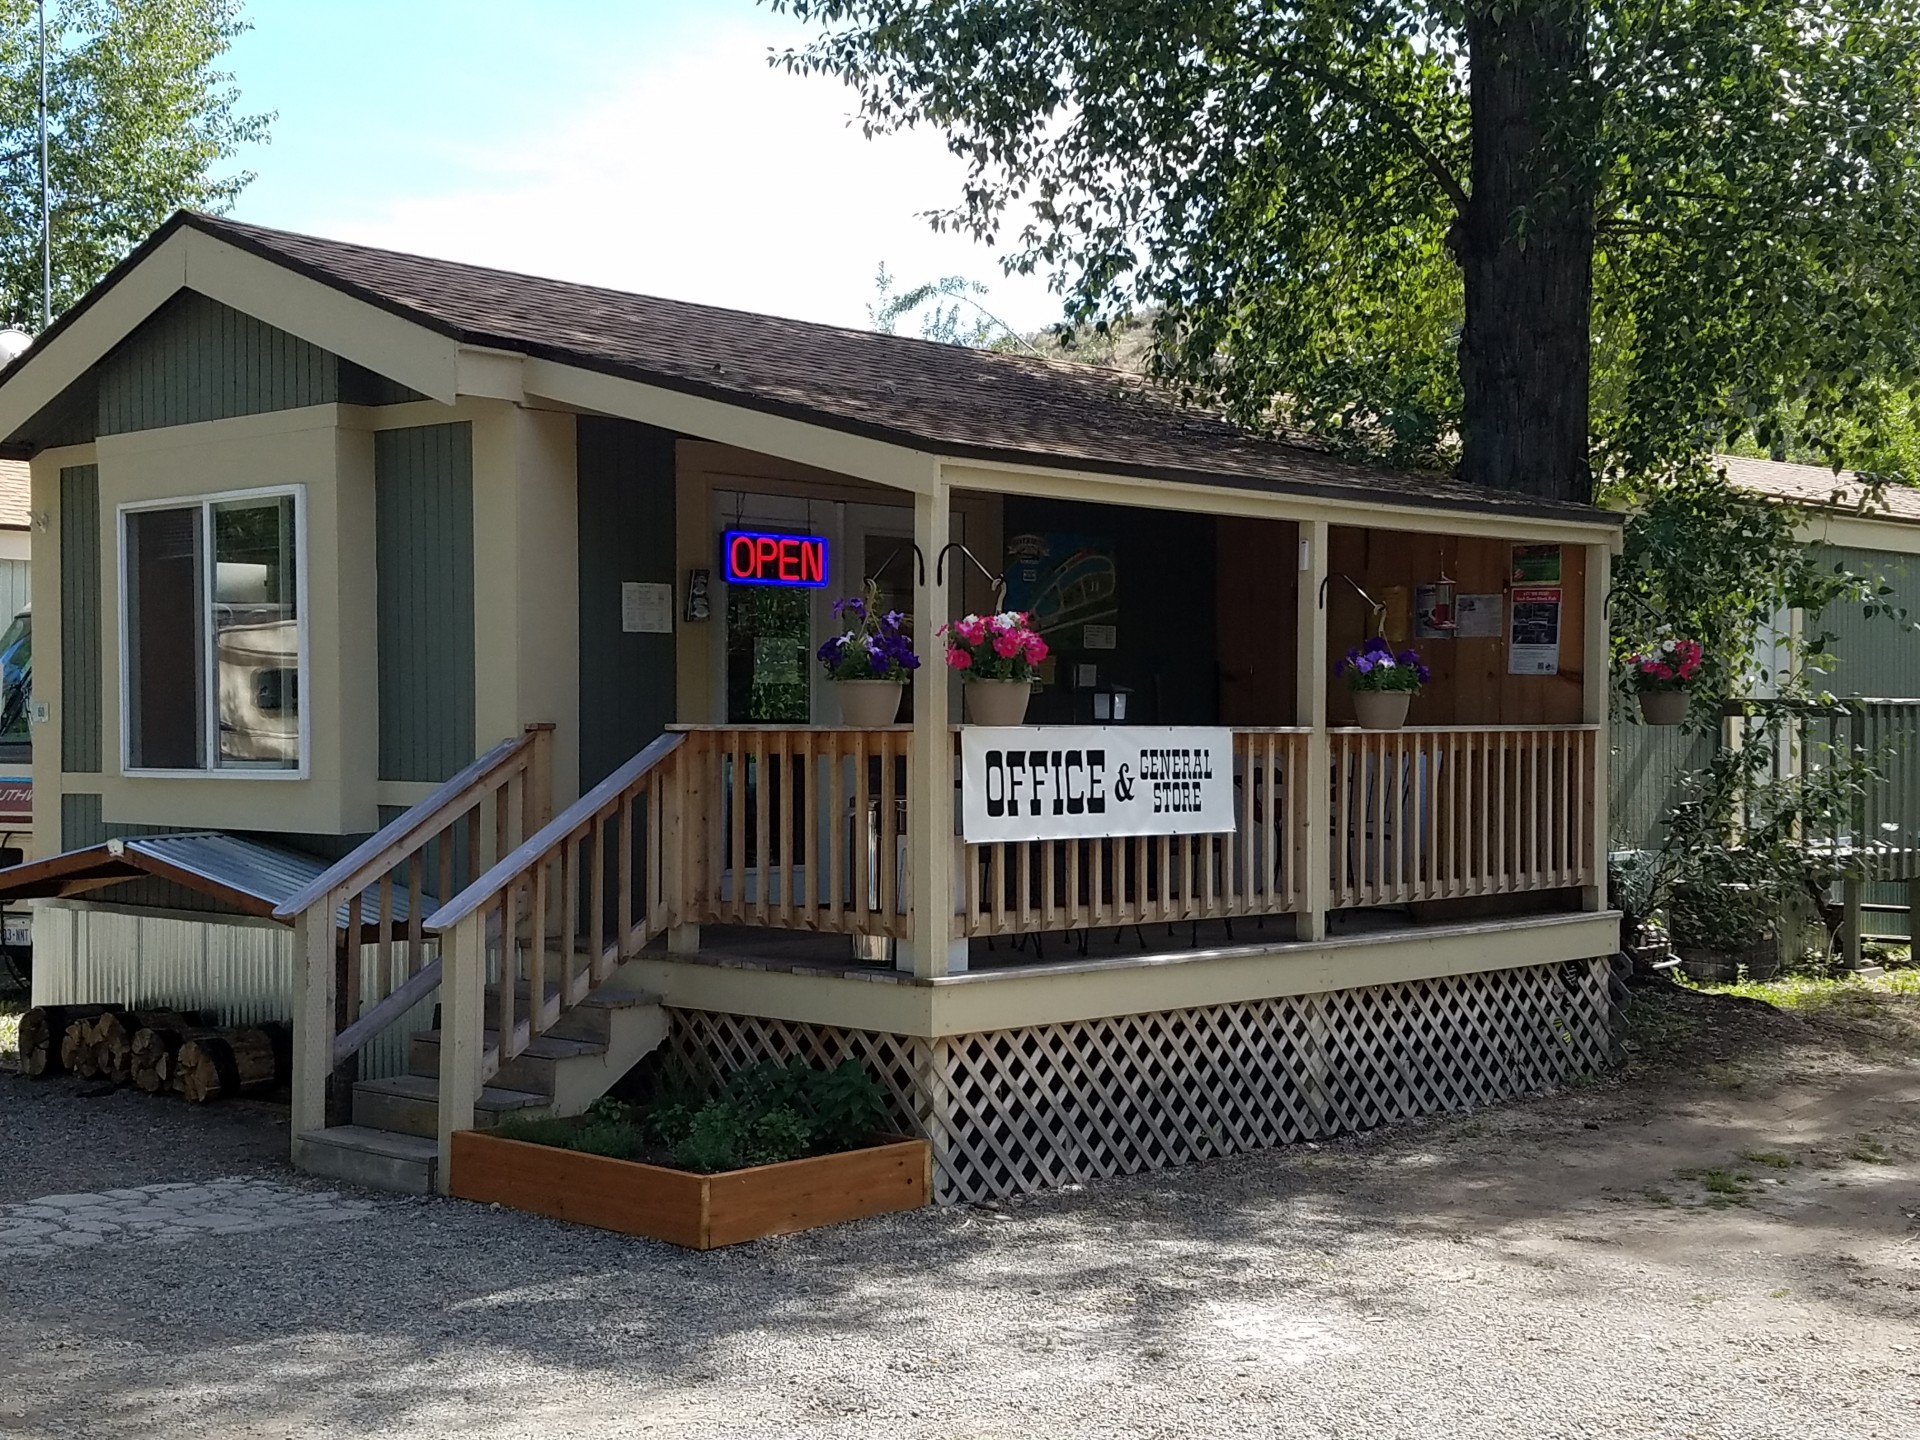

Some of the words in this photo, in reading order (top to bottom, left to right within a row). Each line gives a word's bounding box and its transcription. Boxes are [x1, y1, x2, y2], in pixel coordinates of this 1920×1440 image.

[731, 536, 822, 582] OPEN
[985, 750, 1106, 817] OFFICE
[1114, 762, 1136, 803] &
[1140, 749, 1213, 780] GENERAL
[1153, 782, 1202, 813] STORE
